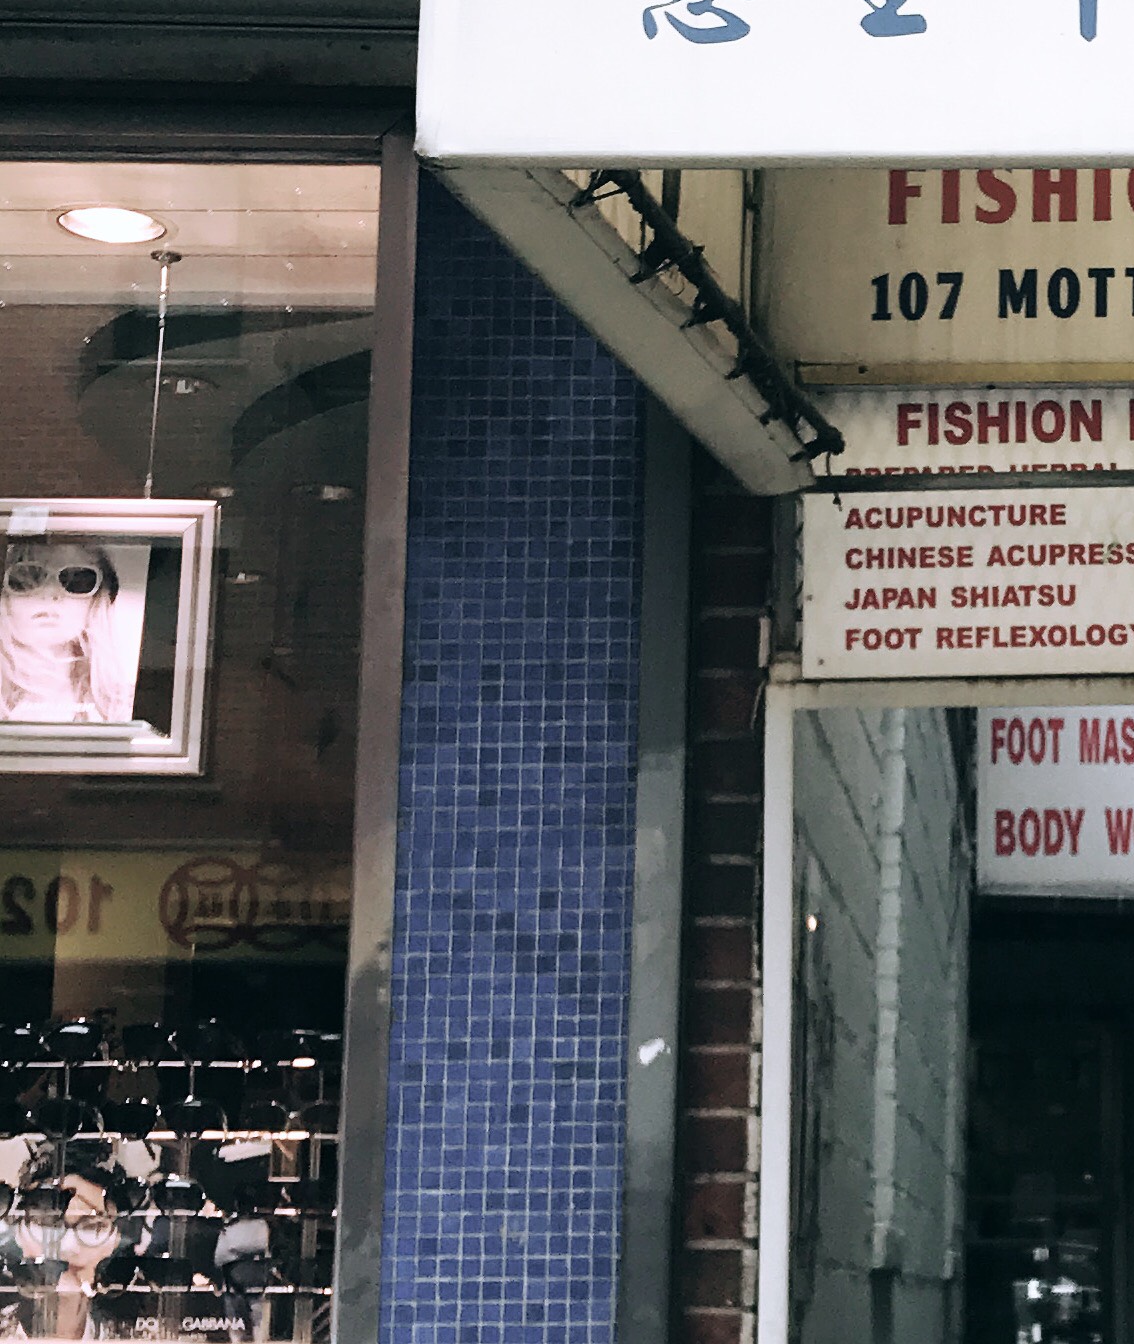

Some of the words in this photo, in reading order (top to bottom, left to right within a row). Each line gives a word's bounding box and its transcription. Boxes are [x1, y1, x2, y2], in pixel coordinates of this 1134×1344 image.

[870, 272, 965, 322] 107
[896, 398, 1104, 447] FISHION
[844, 503, 1068, 531] ACUPUNCTURE
[844, 545, 975, 571] CHINESE
[844, 587, 938, 611] JAPAN
[950, 583, 1078, 609] SHIATSU
[844, 627, 922, 652] FOOT
[991, 716, 1065, 766] FOOT
[995, 806, 1086, 857] BODY
